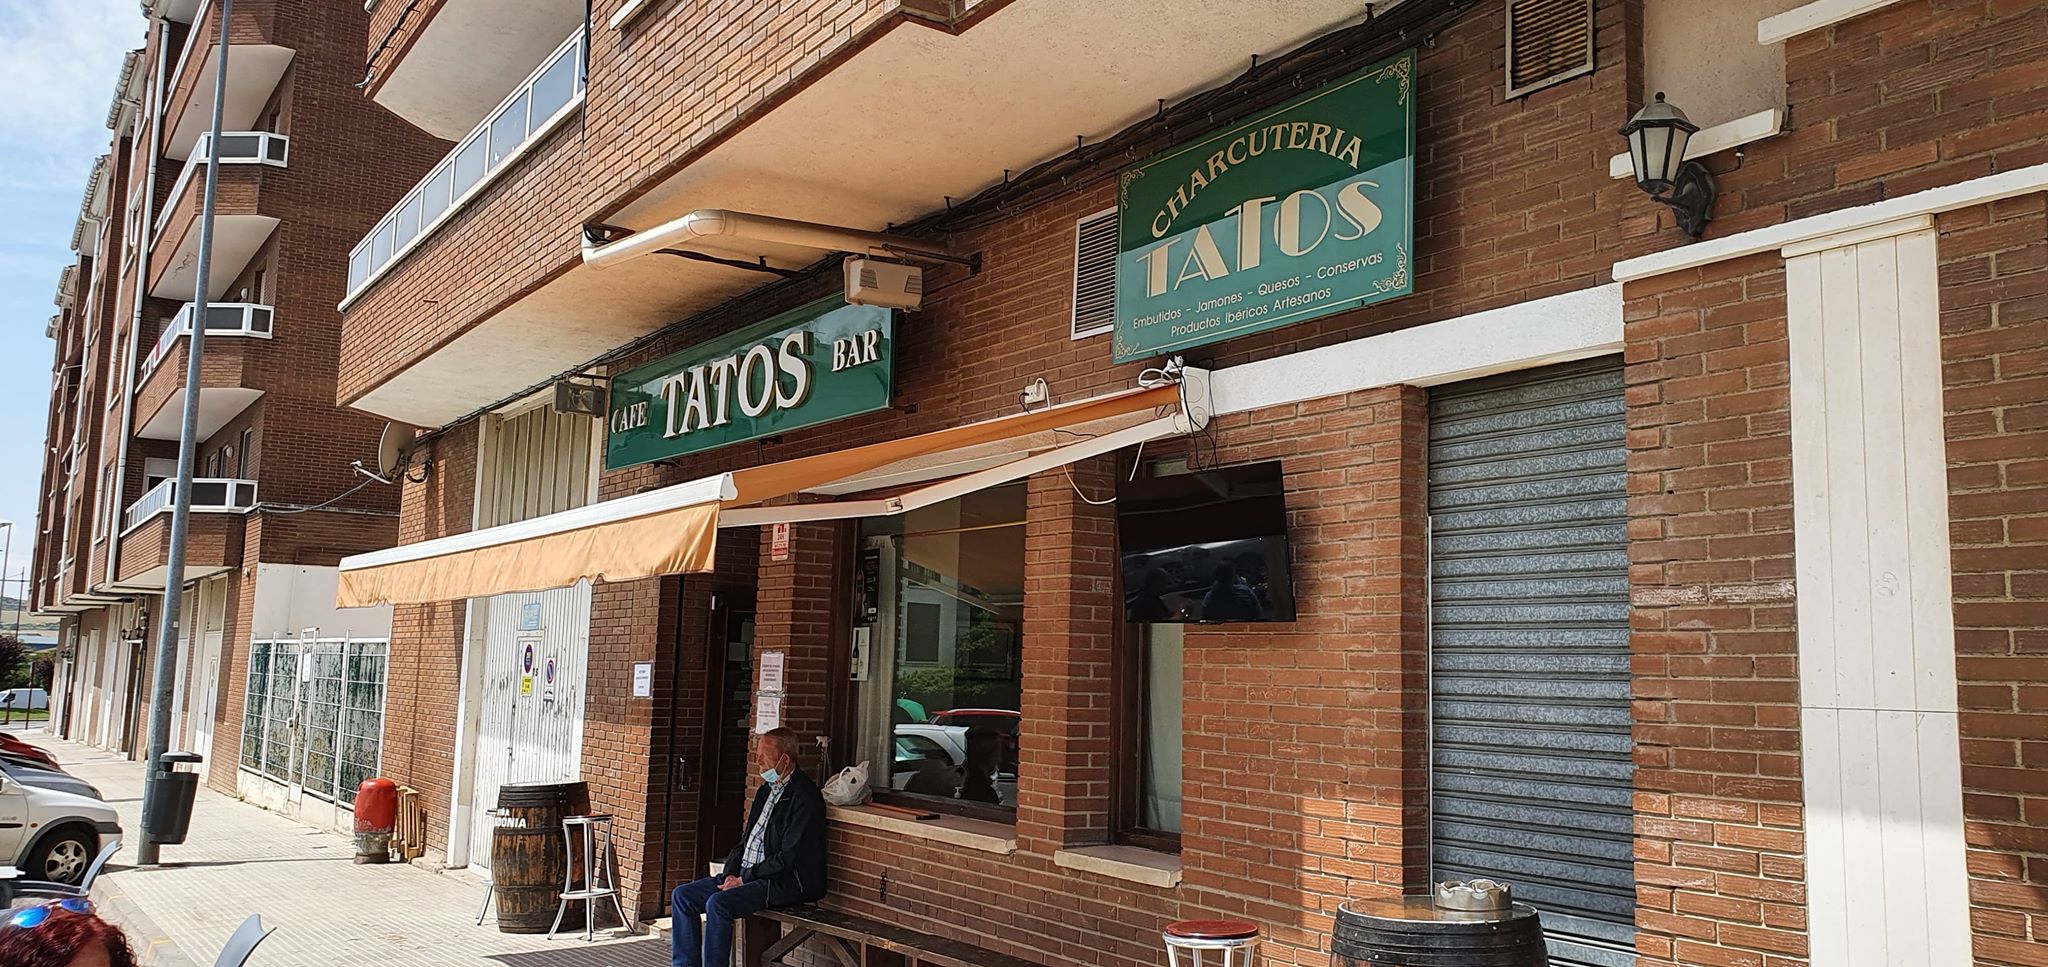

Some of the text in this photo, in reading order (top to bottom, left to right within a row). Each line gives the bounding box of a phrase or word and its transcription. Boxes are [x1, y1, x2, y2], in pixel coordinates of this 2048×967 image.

[1150, 121, 1363, 238] CHARCUTERIA
[1133, 307, 1182, 329] Embutidos
[1195, 292, 1243, 314] Jamones
[1257, 275, 1300, 296] Quesos
[1316, 251, 1383, 280] Conservas
[1135, 181, 1383, 298] TATOS
[1170, 315, 1221, 337] Productos
[1272, 287, 1332, 312] Artesanos
[611, 329, 882, 439] CAFE TATOS BAR
